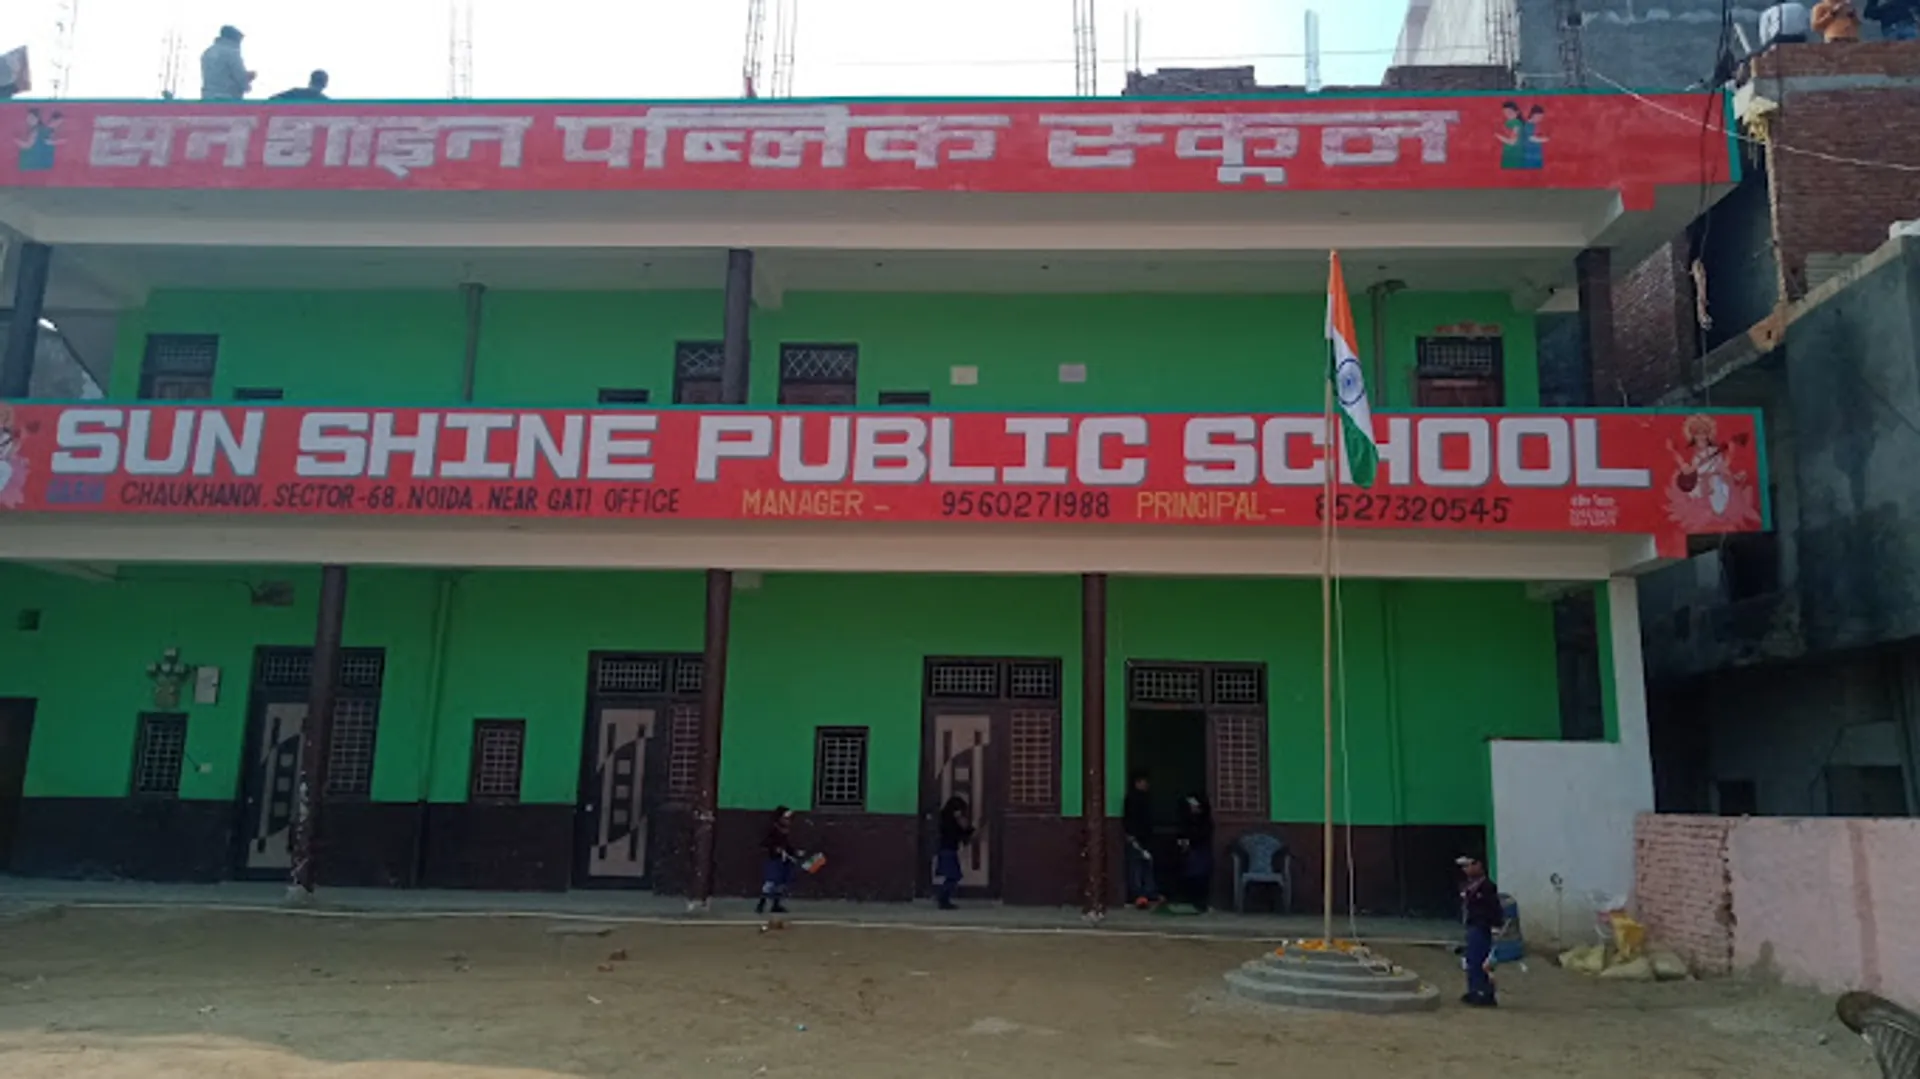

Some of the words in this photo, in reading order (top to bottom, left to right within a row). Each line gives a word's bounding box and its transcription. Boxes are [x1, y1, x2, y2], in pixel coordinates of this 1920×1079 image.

[554, 105, 1010, 168] पब्लिक
[1039, 110, 1459, 184] स्कूल
[50, 409, 264, 476] SUN
[295, 412, 657, 480] SHINE
[695, 414, 1147, 485] PUBLIC
[1183, 416, 1651, 487] SCHOOL
[487, 486, 539, 511] NEAR
[546, 487, 592, 512] GATI
[604, 488, 680, 513] OFFICE
[941, 491, 1111, 518] 9560271988
